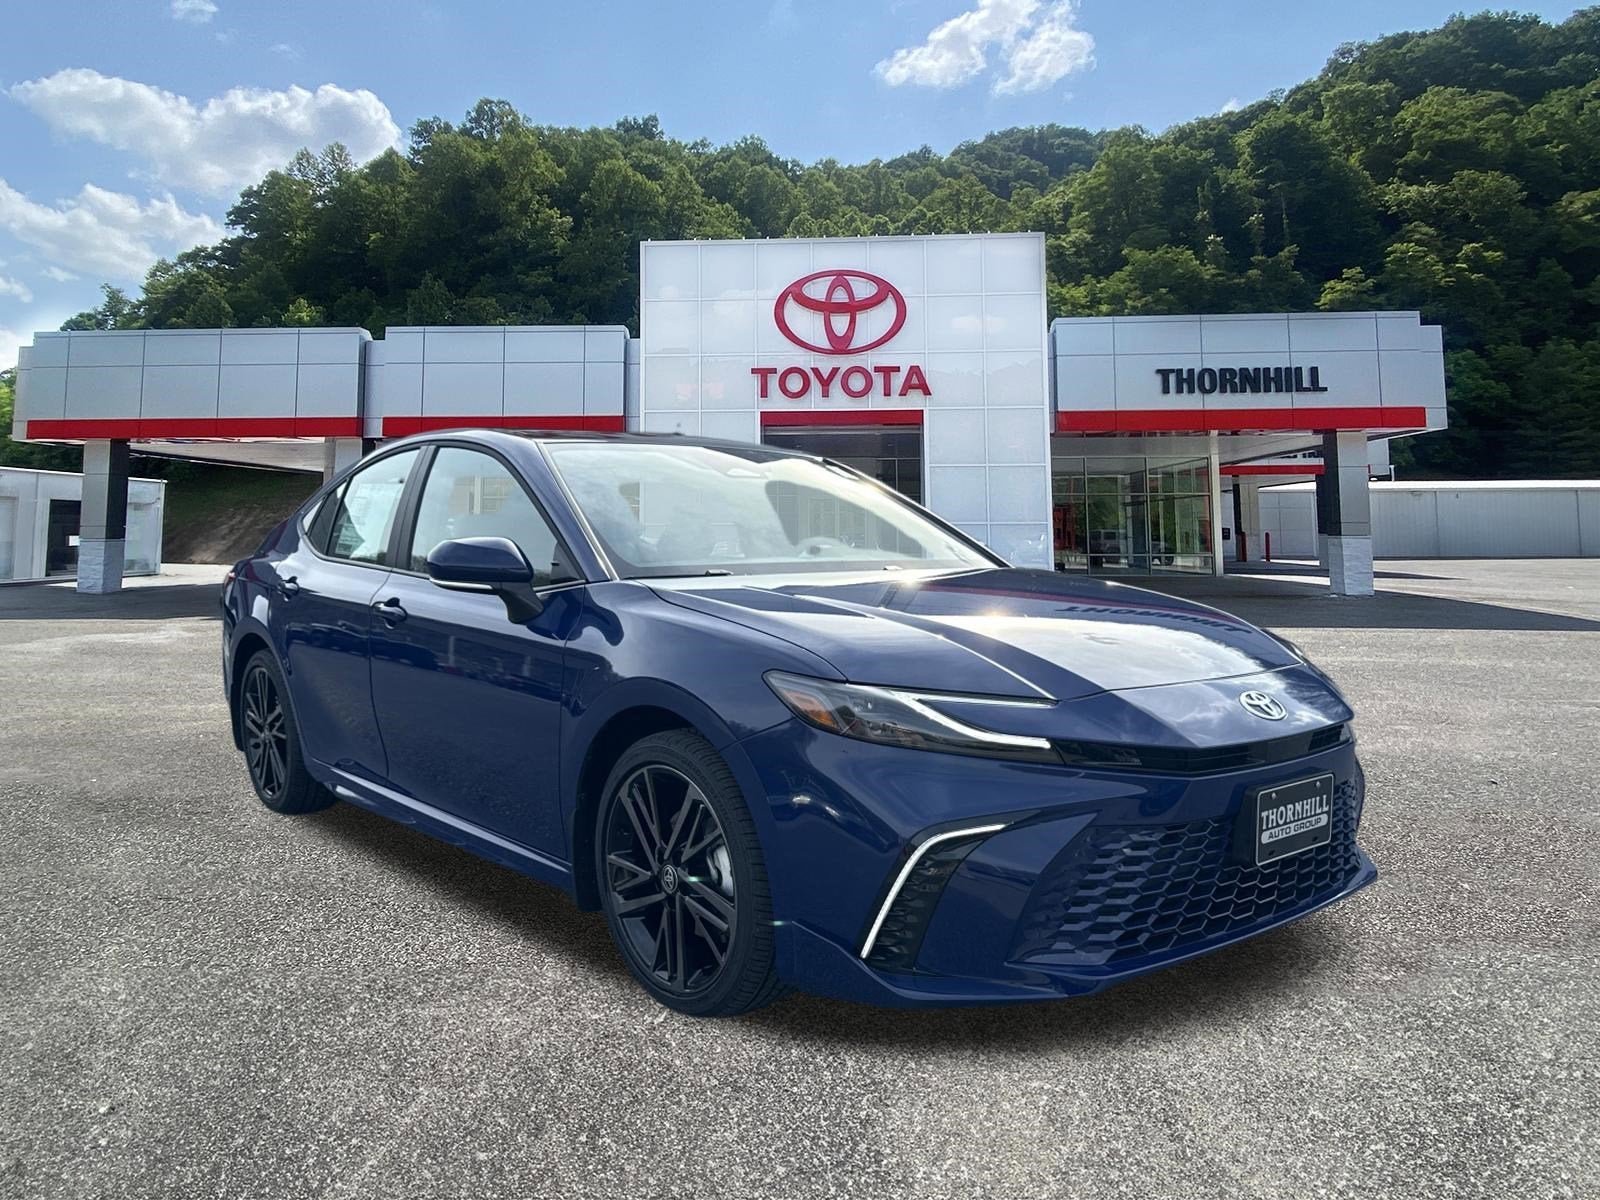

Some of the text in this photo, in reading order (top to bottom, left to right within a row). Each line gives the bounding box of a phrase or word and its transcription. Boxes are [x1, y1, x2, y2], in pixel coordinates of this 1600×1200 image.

[751, 365, 932, 398] TOYOTA
[1155, 366, 1328, 394] THORNHILL
[1261, 795, 1329, 830] THORNHILL
[1267, 816, 1322, 840] AUTO GROUP
